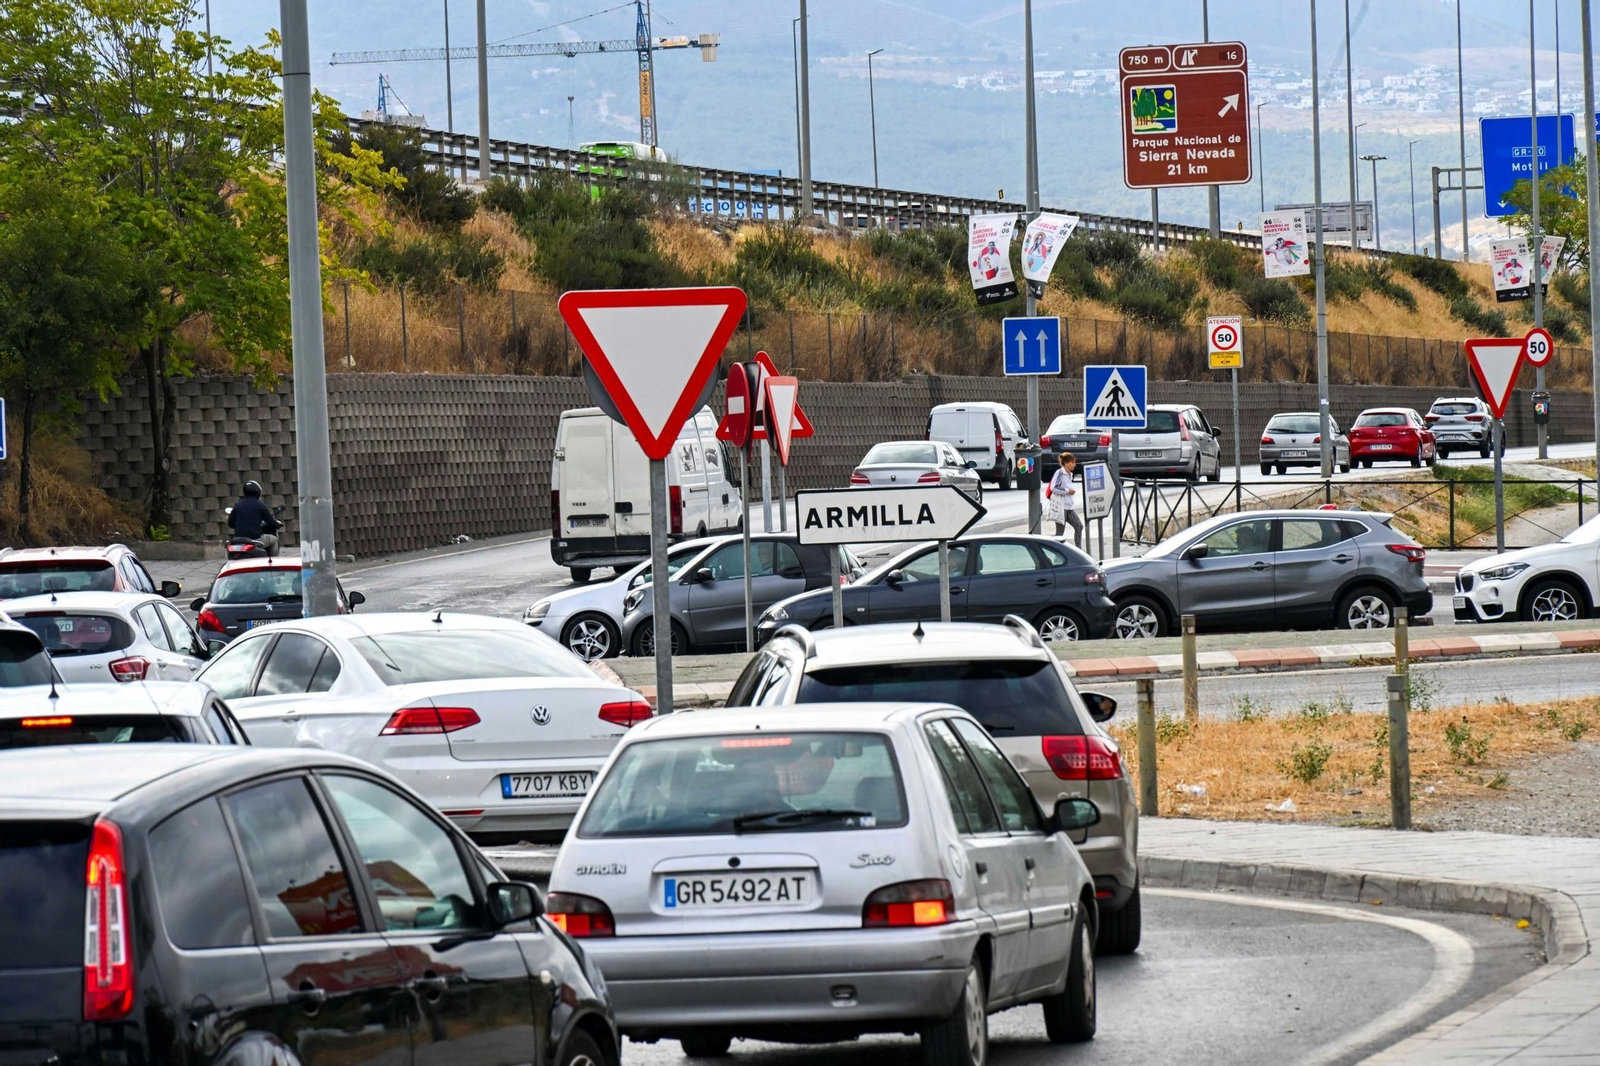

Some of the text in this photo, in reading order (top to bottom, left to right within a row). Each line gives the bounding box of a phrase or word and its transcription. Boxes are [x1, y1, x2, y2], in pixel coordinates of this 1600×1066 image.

[1128, 55, 1164, 66] 750 m
[1226, 51, 1237, 60] 16
[1132, 134, 1241, 149] Parque Nacional de
[1139, 148, 1235, 162] Sierra Nevada
[1514, 147, 1544, 156] GR-0
[1167, 163, 1208, 175] 21 km
[1512, 161, 1548, 171] Motil
[1033, 222, 1058, 230] PUEBLOS
[1218, 333, 1232, 342] 50
[1530, 341, 1546, 354] 50
[804, 503, 936, 529] ARMILLA
[512, 775, 553, 793] 7707
[558, 774, 588, 791] KBY
[574, 864, 627, 876] CITROËN
